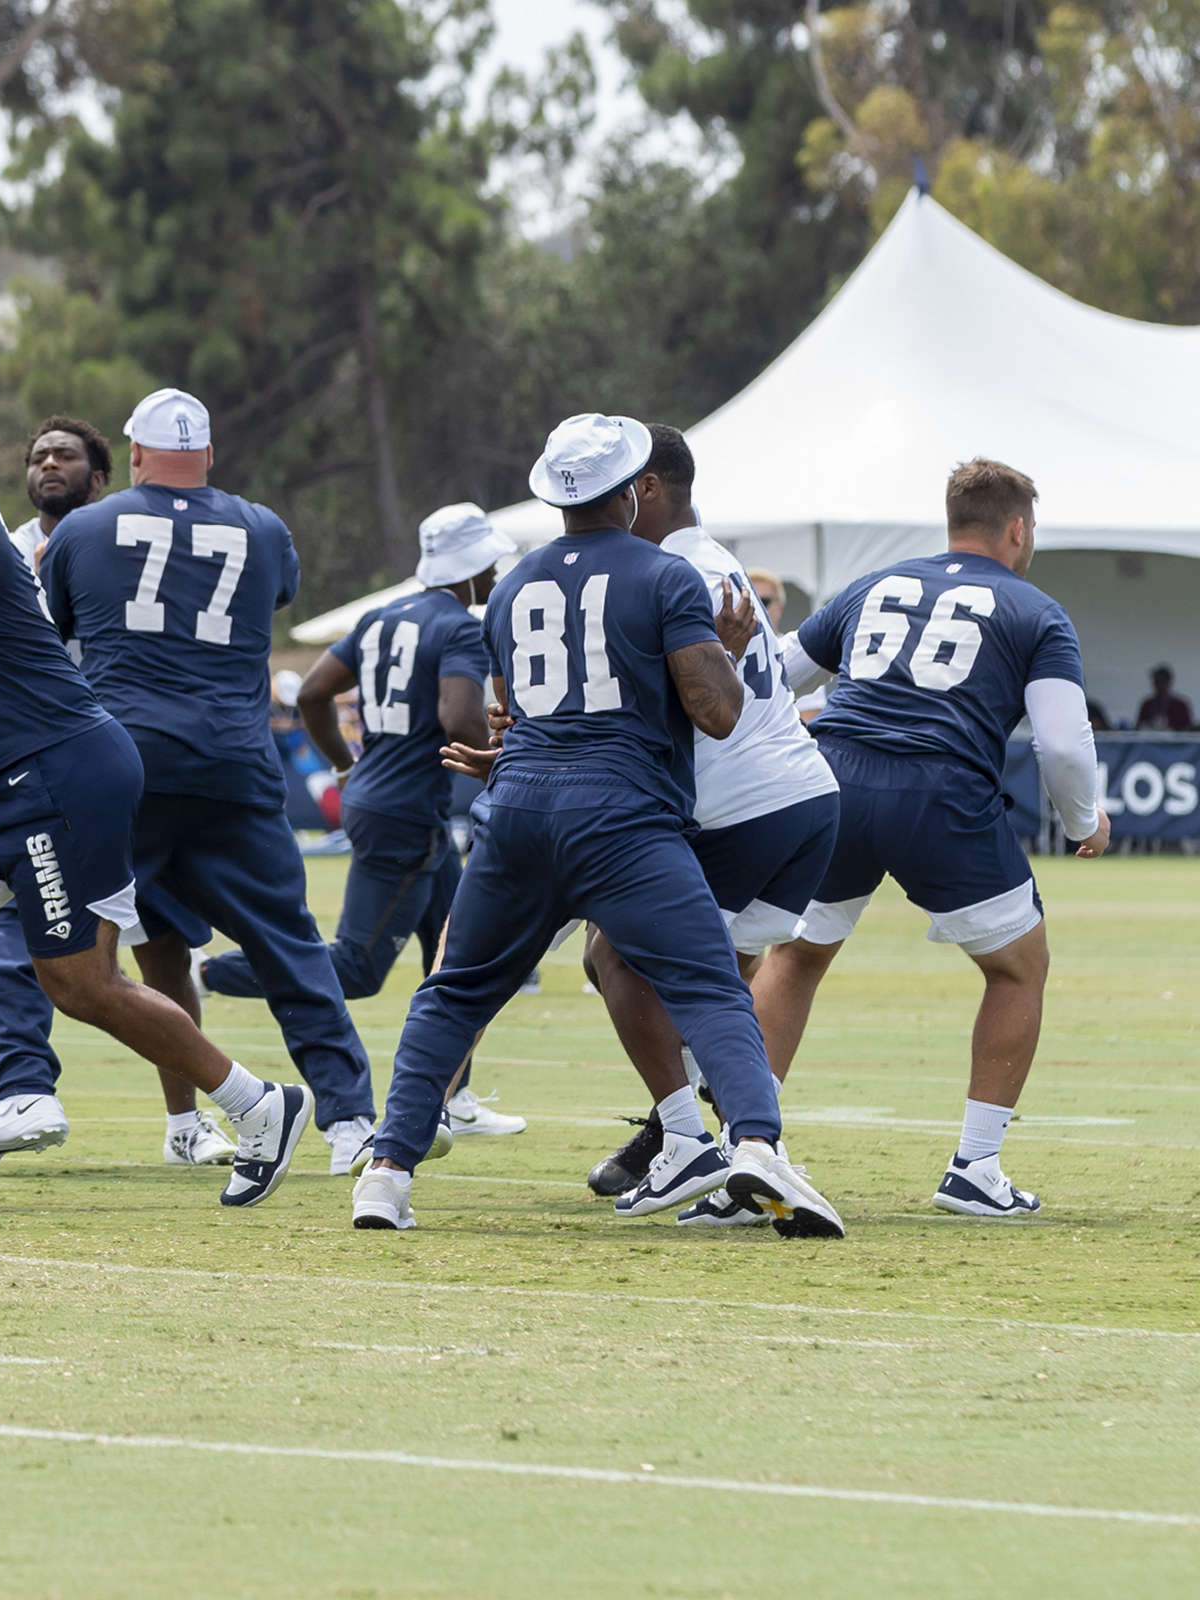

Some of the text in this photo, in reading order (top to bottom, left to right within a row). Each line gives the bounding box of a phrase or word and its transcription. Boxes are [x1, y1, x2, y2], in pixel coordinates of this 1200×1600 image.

[116, 514, 248, 645] 77
[849, 575, 996, 691] 66
[360, 620, 419, 736] 12
[511, 573, 622, 718] 81
[1096, 761, 1199, 815] LOS
[26, 833, 72, 921] RAMS
